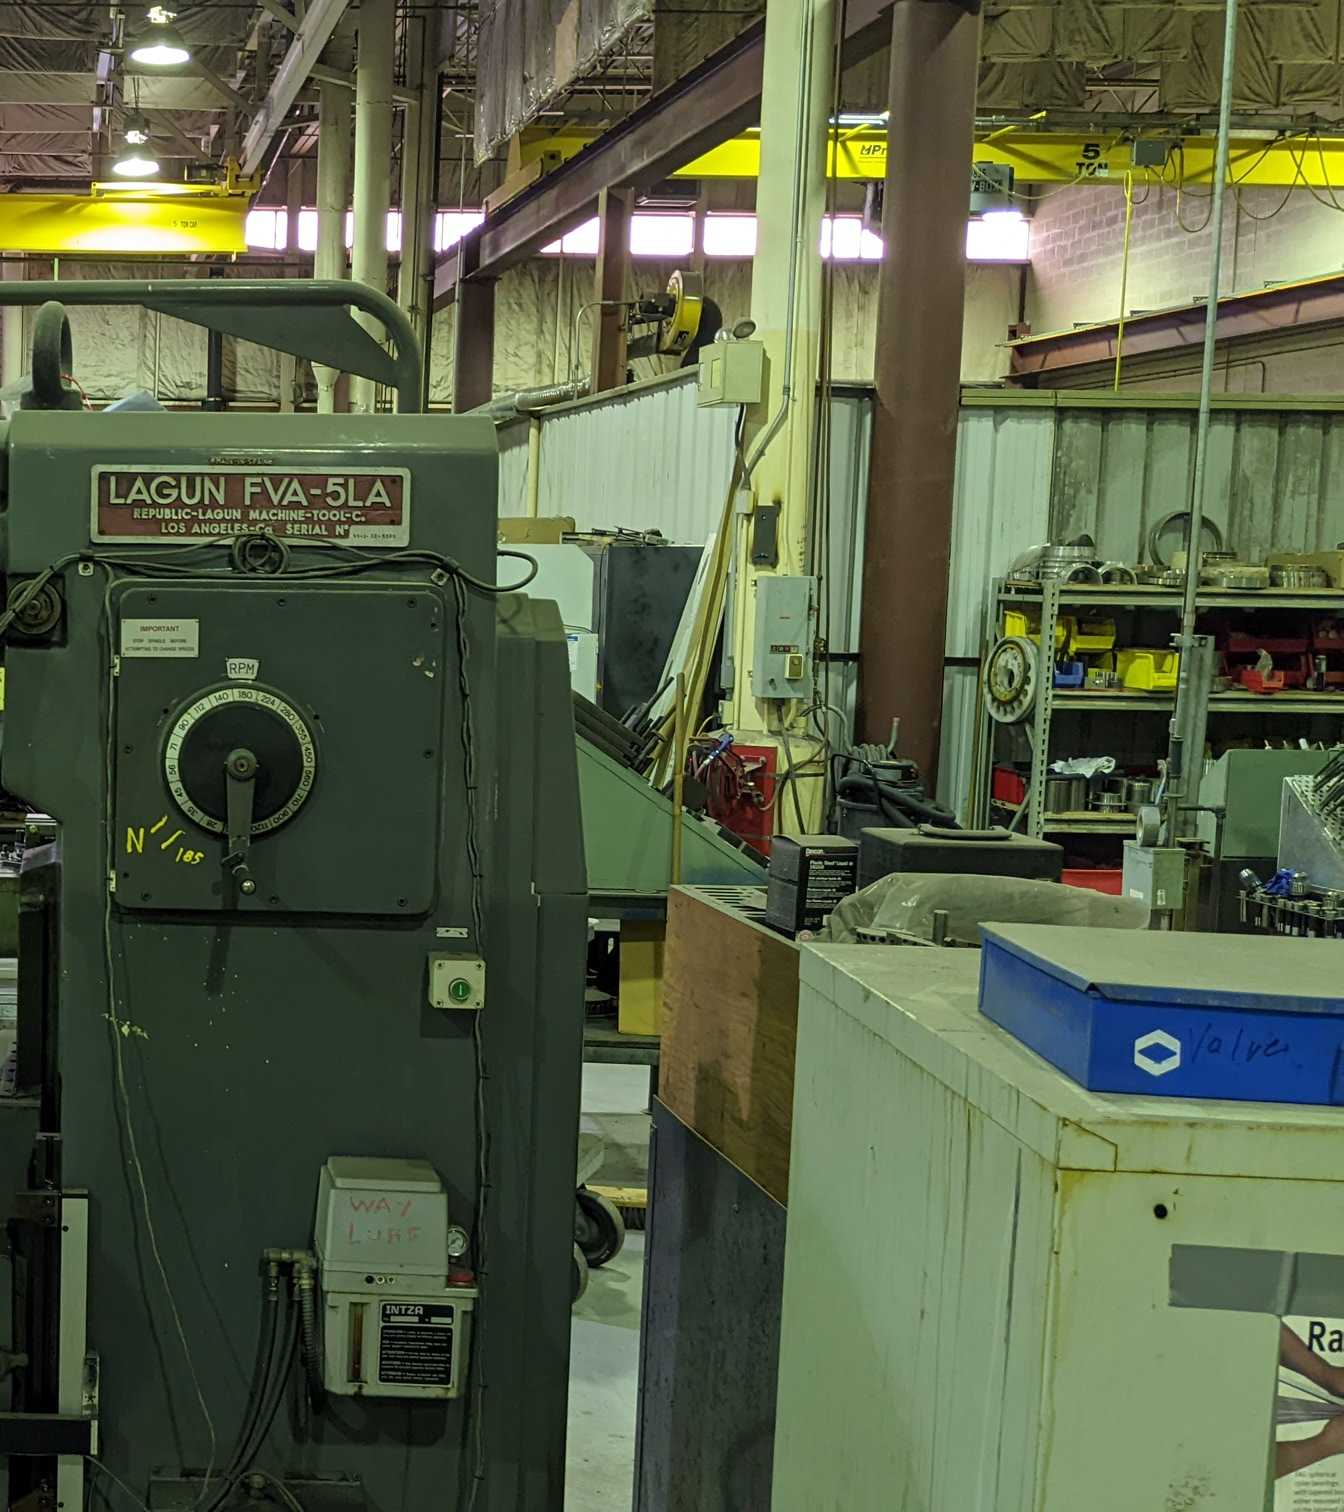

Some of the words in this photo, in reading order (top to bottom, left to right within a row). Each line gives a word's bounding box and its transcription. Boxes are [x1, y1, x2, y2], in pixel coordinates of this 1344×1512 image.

[1082, 143, 1101, 161] 5
[1076, 162, 1108, 176] TON
[109, 475, 227, 506] LAGUN
[244, 476, 392, 508] FVA-5LA
[133, 507, 242, 521] REPUBLIC-LAGUN
[160, 522, 186, 535] LOS
[285, 523, 329, 535] SERIAL
[228, 661, 256, 676] RPM
[213, 691, 230, 703] 140
[237, 690, 253, 700] 180
[260, 694, 277, 707] 224
[193, 702, 206, 714] 112
[279, 706, 297, 722] 280
[178, 719, 190, 732] 90
[169, 742, 178, 752] 71
[168, 764, 177, 775] 56
[127, 826, 145, 853] N
[349, 1196, 413, 1217] WAY
[385, 1305, 424, 1315] INTZA
